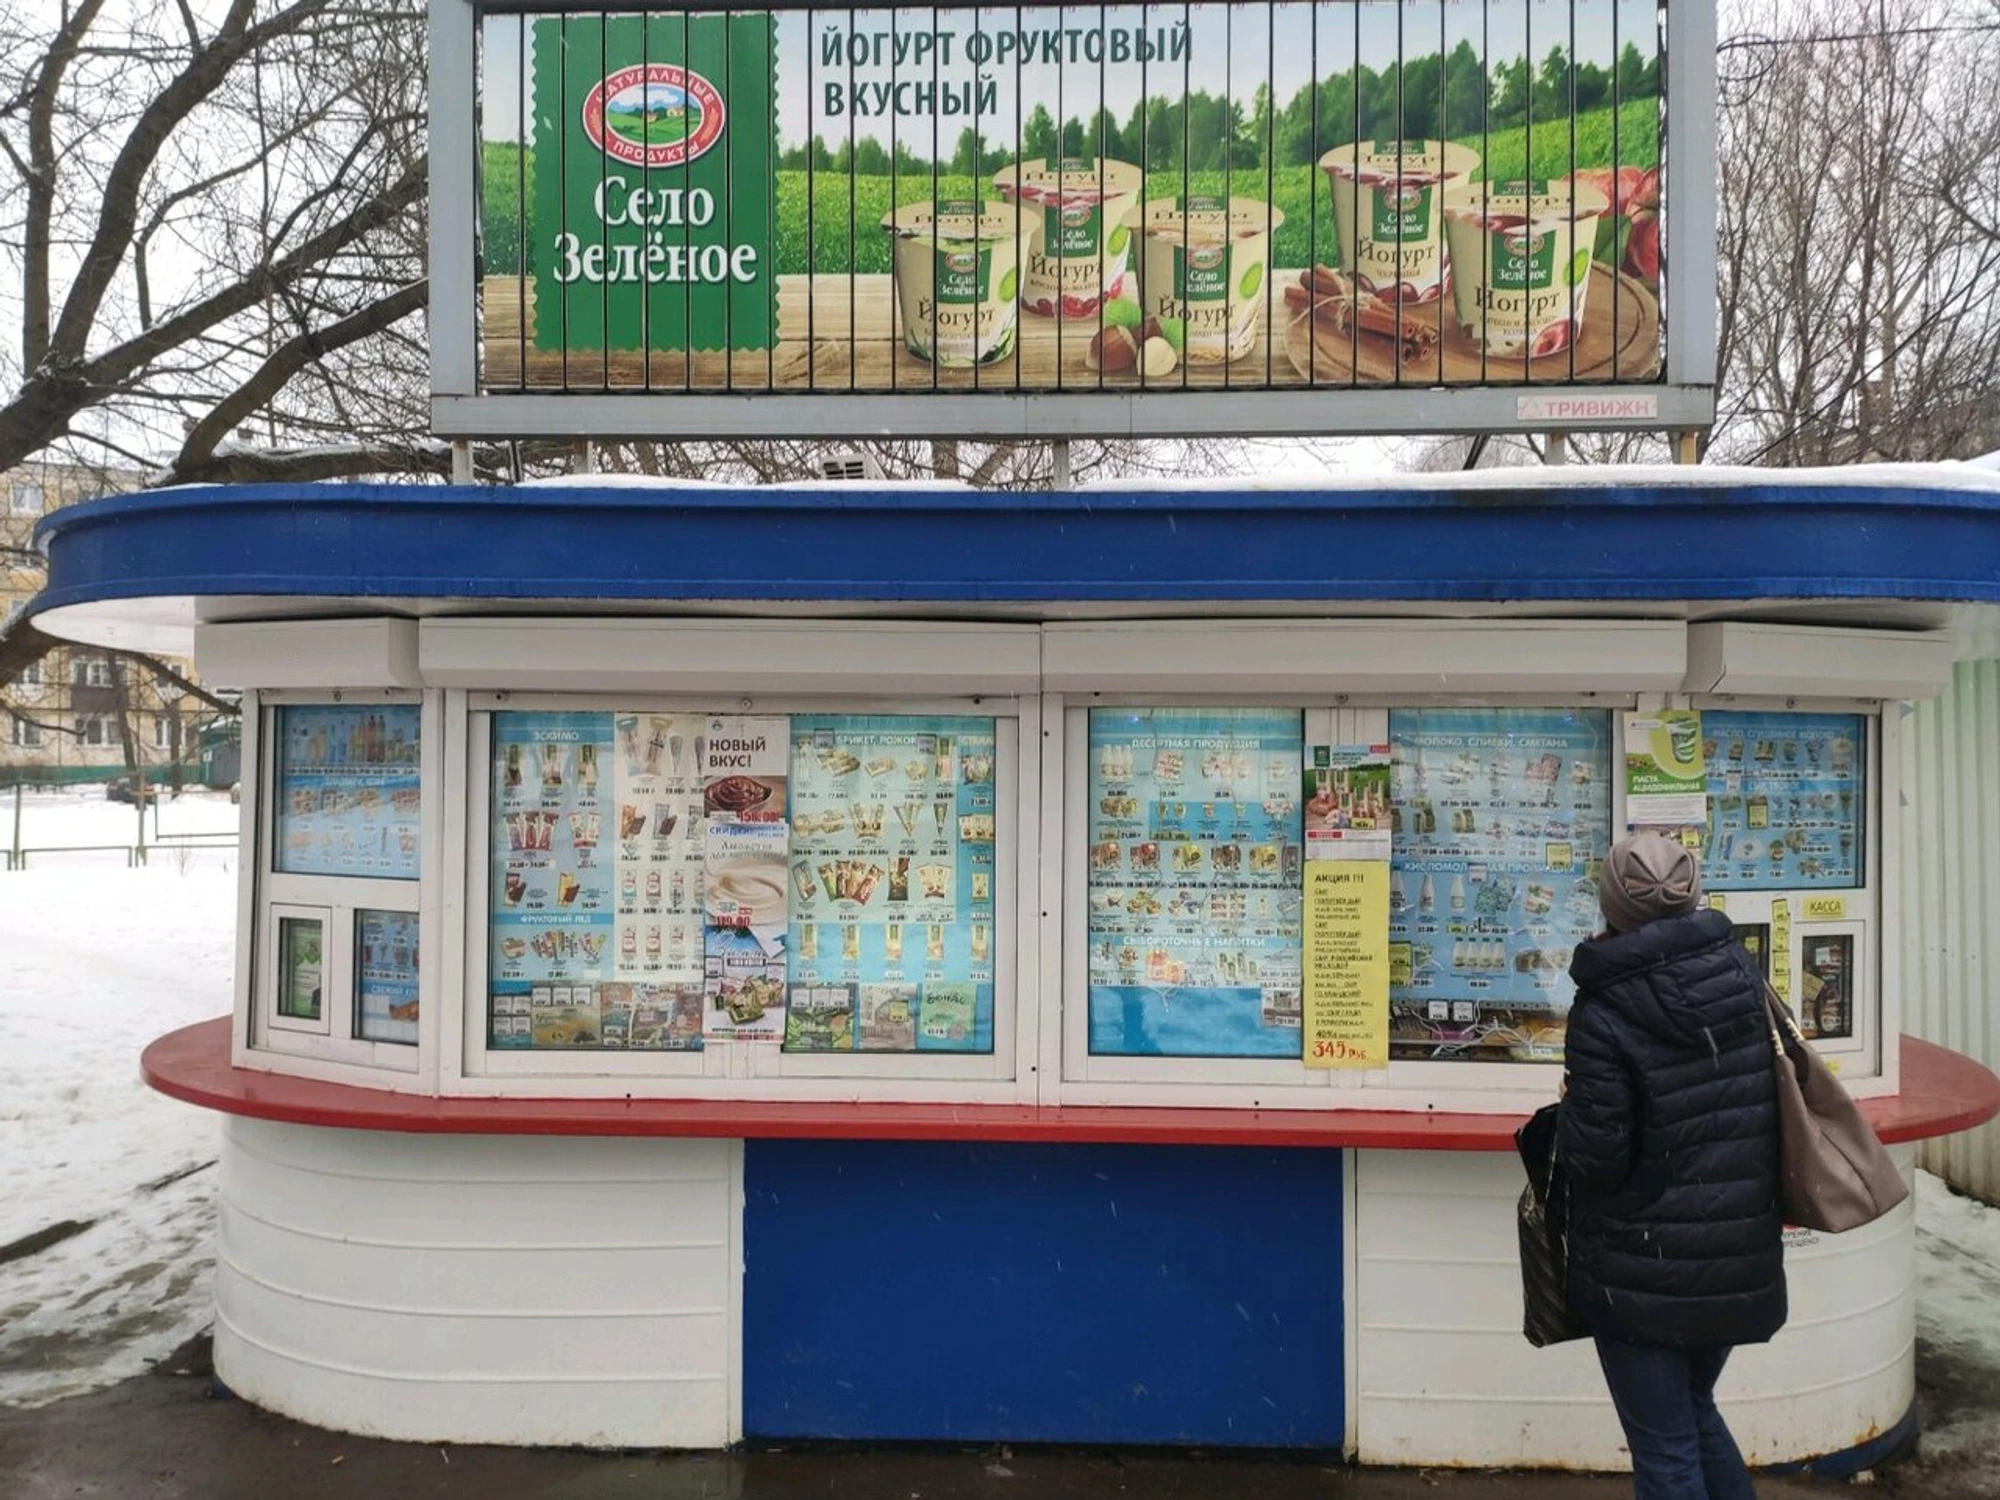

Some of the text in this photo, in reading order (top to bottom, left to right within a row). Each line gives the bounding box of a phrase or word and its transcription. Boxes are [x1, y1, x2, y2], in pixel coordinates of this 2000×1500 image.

[821, 19, 1192, 67] ЙОГУРТ ФРУКТОВЫЙ
[824, 73, 997, 116] ВКУСНЫЙ
[613, 142, 699, 162] ПРОДУКТЫ
[594, 176, 715, 226] Село
[553, 231, 757, 282] Зелёное
[1508, 258, 1539, 269] Сео
[1545, 400, 1650, 416] ТРИВИЖН
[710, 737, 766, 752] НОВЫЙ
[710, 755, 752, 768] ВКУС!
[1315, 874, 1350, 885] АКЦИЯ
[1810, 901, 1842, 912] КАССА
